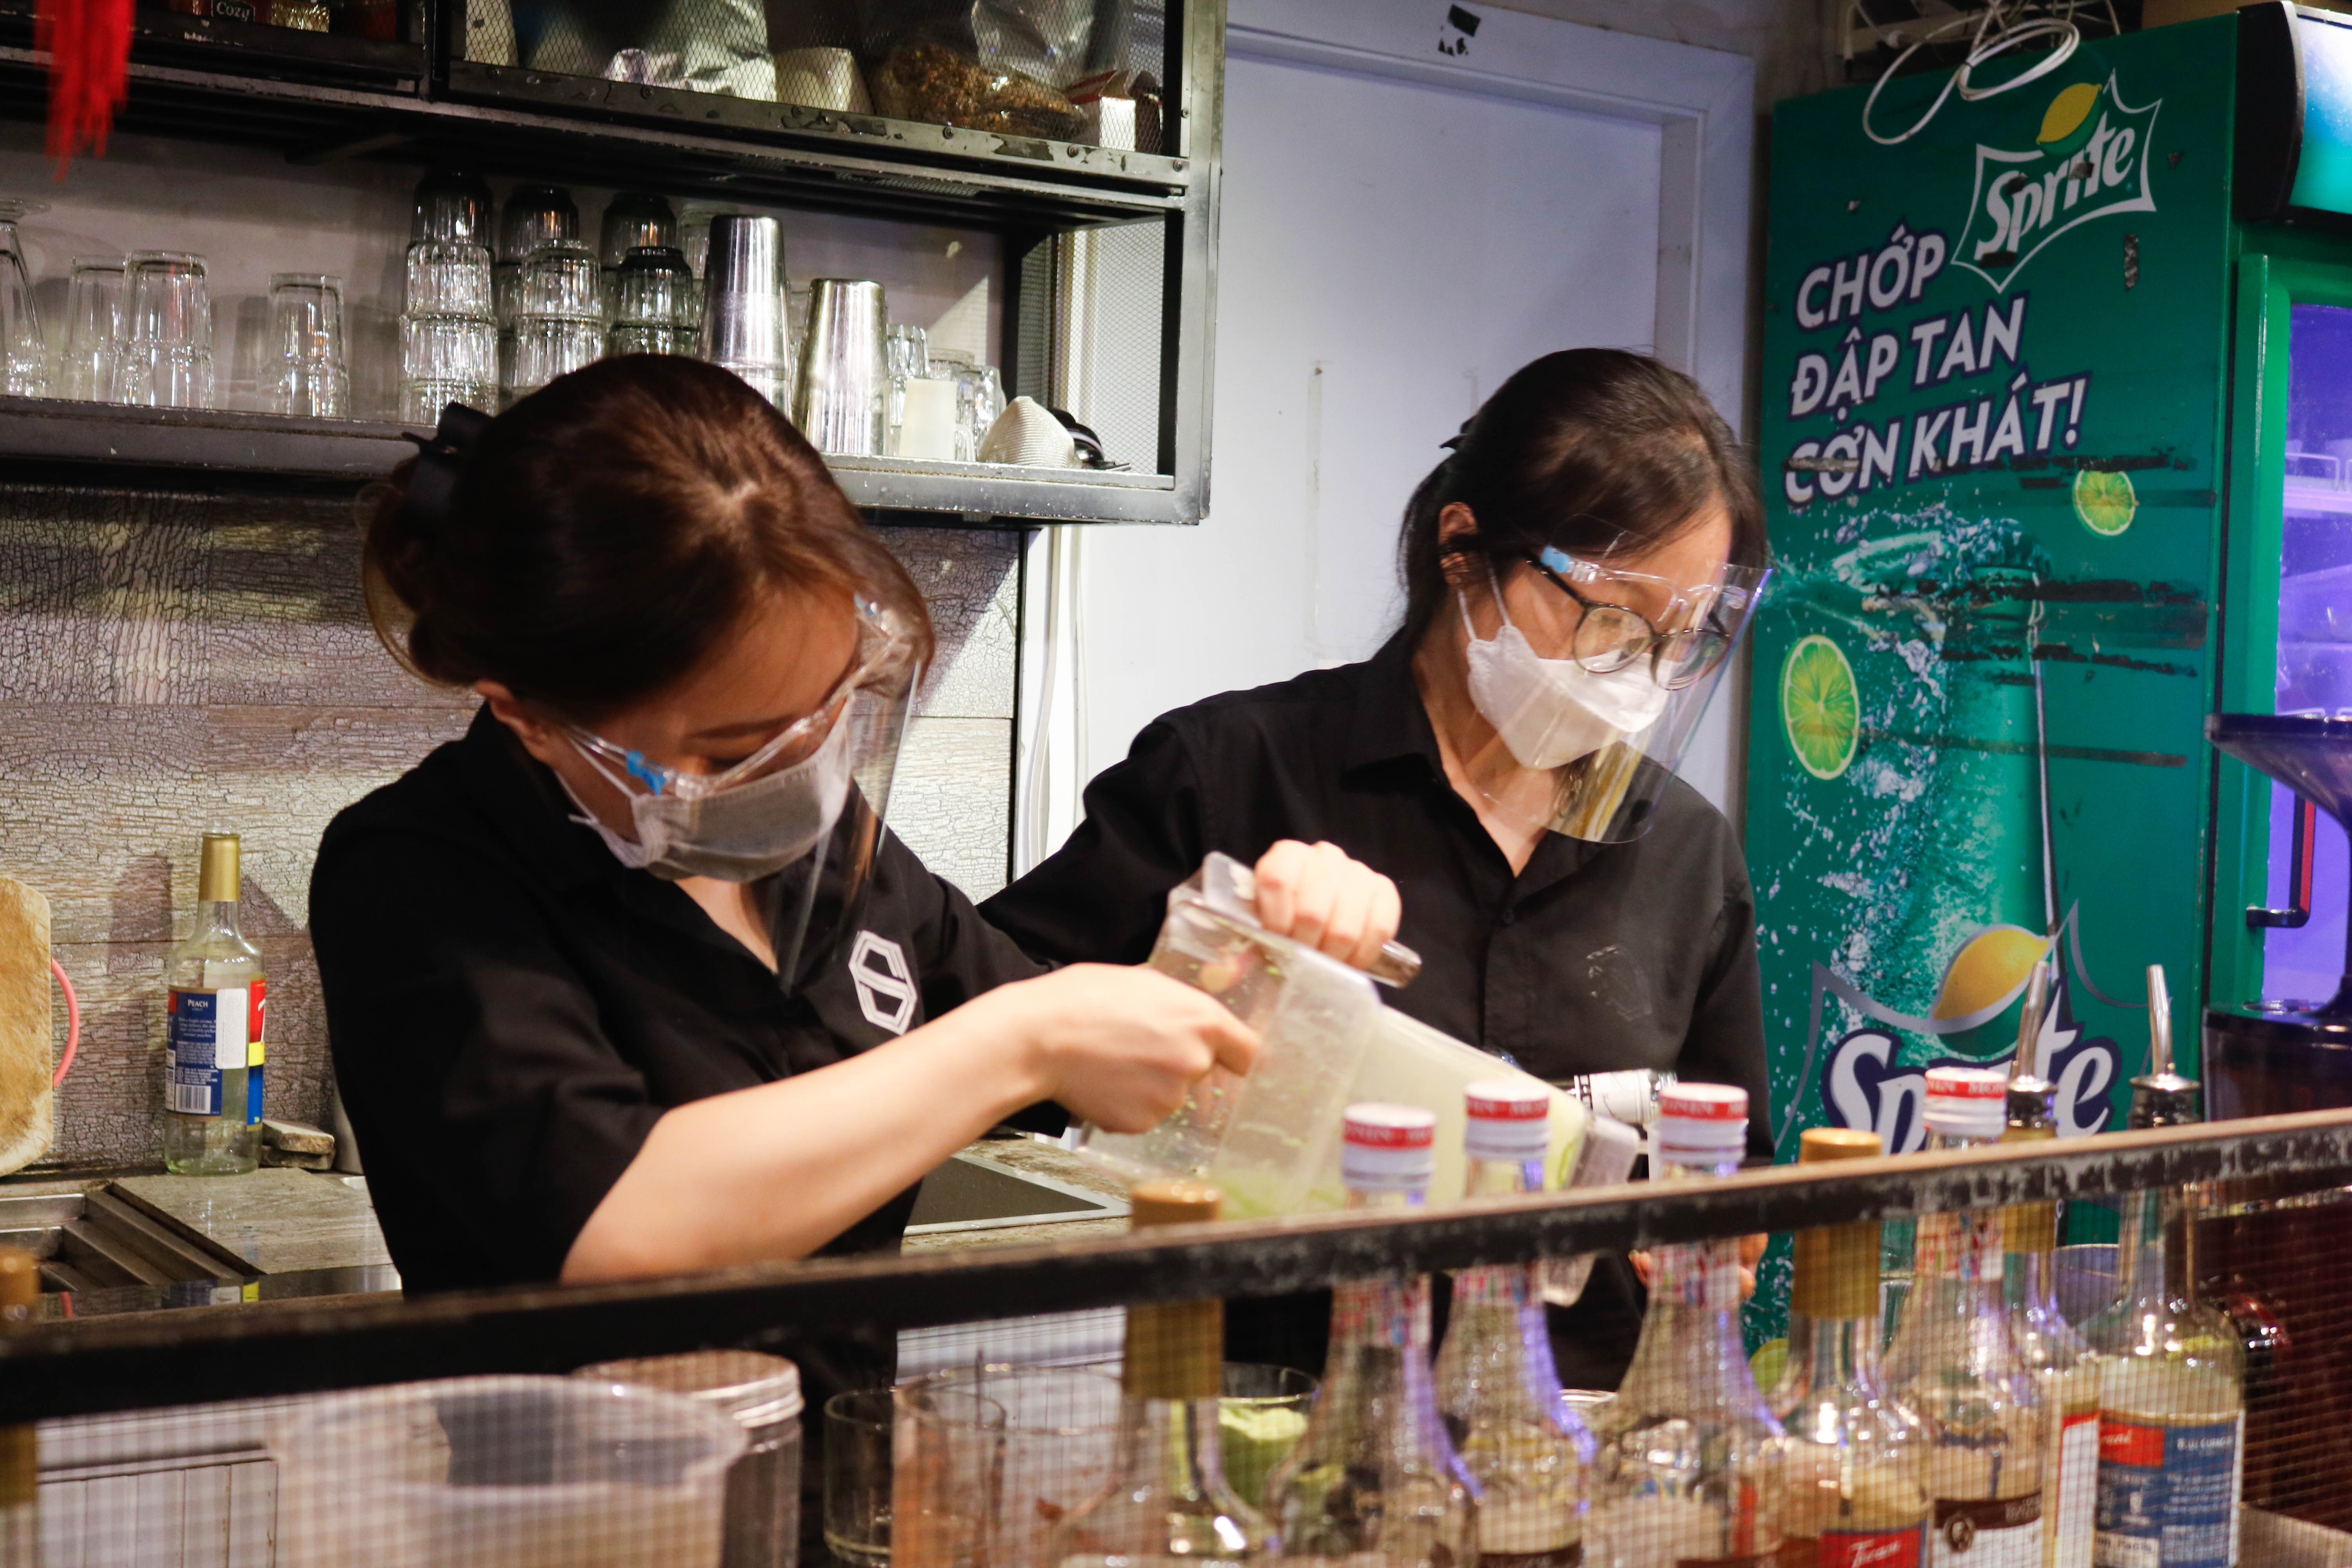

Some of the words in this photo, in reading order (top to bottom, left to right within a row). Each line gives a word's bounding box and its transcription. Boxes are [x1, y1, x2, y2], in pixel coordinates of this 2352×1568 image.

[216, 2, 250, 22] Cozy
[1974, 110, 2135, 261] Sprite
[1796, 224, 1946, 328] CHỚP
[1791, 326, 1899, 421] ĐẬP
[1911, 298, 2025, 385] TAN
[1785, 421, 1902, 503] CƠN
[1908, 371, 2087, 478] KHÁT!
[187, 999, 209, 1008] PEACH
